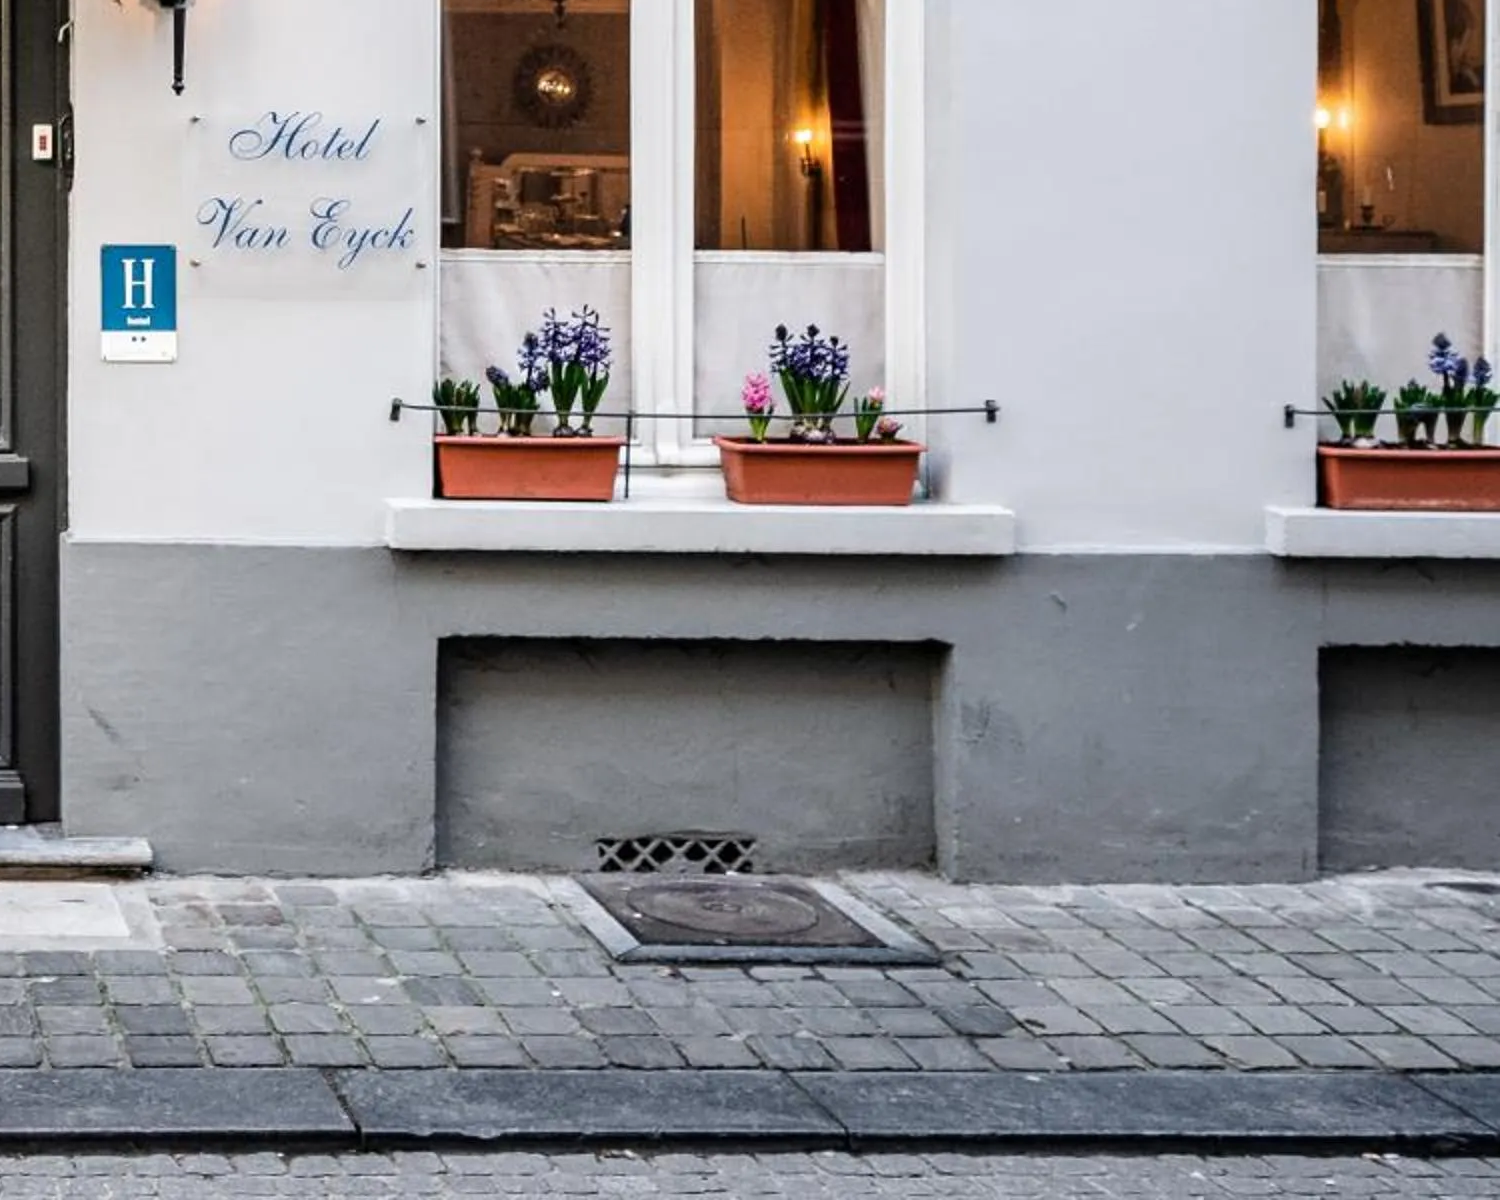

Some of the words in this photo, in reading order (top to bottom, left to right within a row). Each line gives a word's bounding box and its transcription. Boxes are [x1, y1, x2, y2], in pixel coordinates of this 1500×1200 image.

[228, 111, 380, 161] Hotel
[196, 197, 291, 250] Van
[309, 198, 414, 269] Eyck
[121, 259, 155, 308] H
